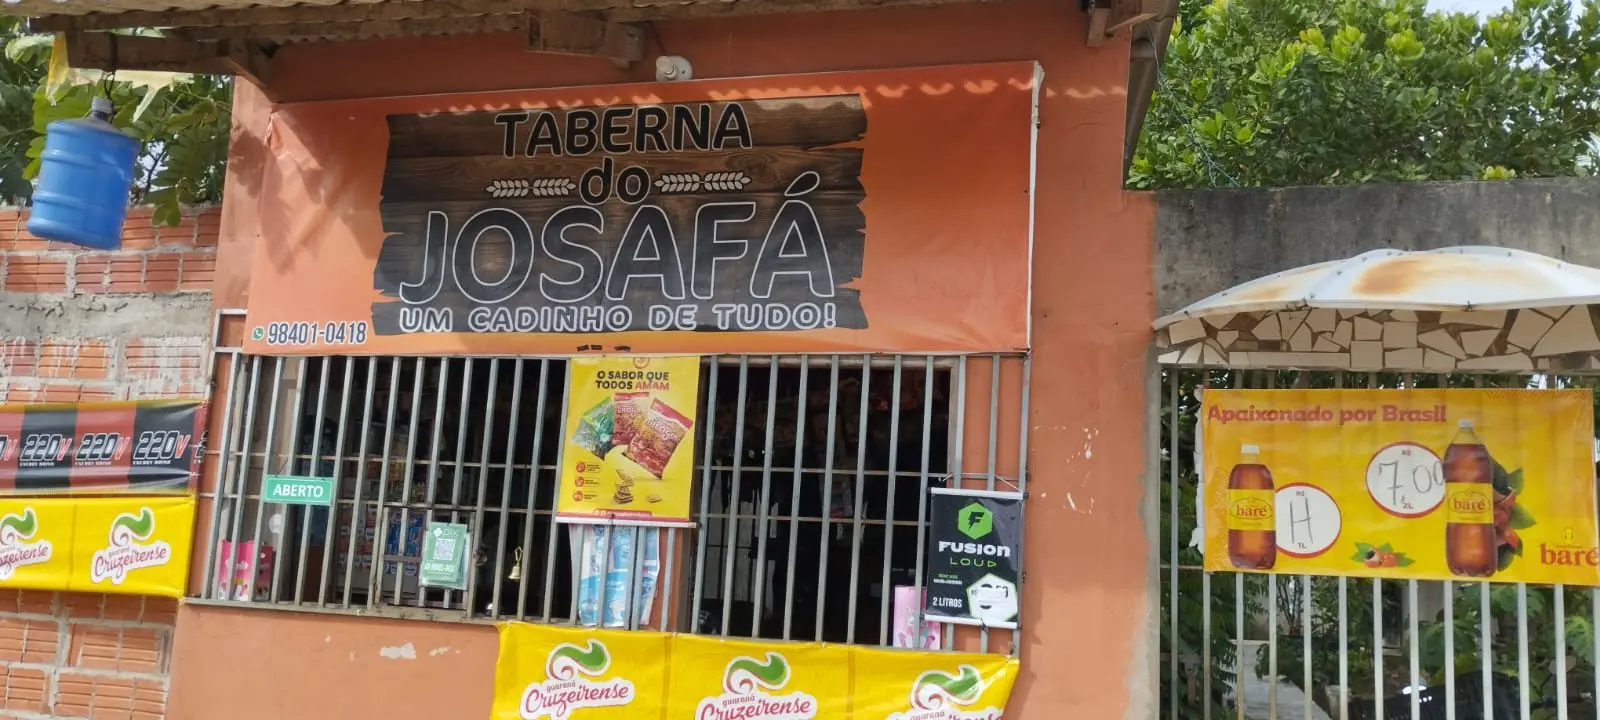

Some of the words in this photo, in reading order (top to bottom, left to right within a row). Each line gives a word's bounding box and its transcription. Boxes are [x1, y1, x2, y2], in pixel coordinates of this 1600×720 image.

[495, 102, 753, 158] TABERNA
[579, 158, 651, 205] do
[399, 171, 835, 304] JOSAFÁ
[399, 306, 453, 333] UM
[468, 306, 632, 332] CADINHO
[648, 304, 698, 331] DE
[712, 303, 837, 330] TUDO!
[267, 321, 368, 345] 98401-0418
[595, 380, 633, 390] TODOS
[634, 381, 669, 391] AMAM
[597, 370, 605, 379] O
[607, 371, 643, 380] SABOR
[645, 372, 669, 381] QUE
[1207, 404, 1334, 424] Apaixonado
[1339, 408, 1376, 426] por
[1382, 405, 1447, 423] Brasil
[20, 433, 72, 461] 220V
[75, 432, 131, 461] 220V
[133, 430, 191, 460] 220V
[273, 483, 324, 498] ABERTO
[95, 547, 167, 579] Cruzeirense
[950, 557, 997, 568] LOUD
[932, 597, 938, 606] 2
[939, 597, 962, 609] LITROS
[525, 684, 629, 718] Cruzeirense
[700, 697, 811, 720] Cruzeirense
